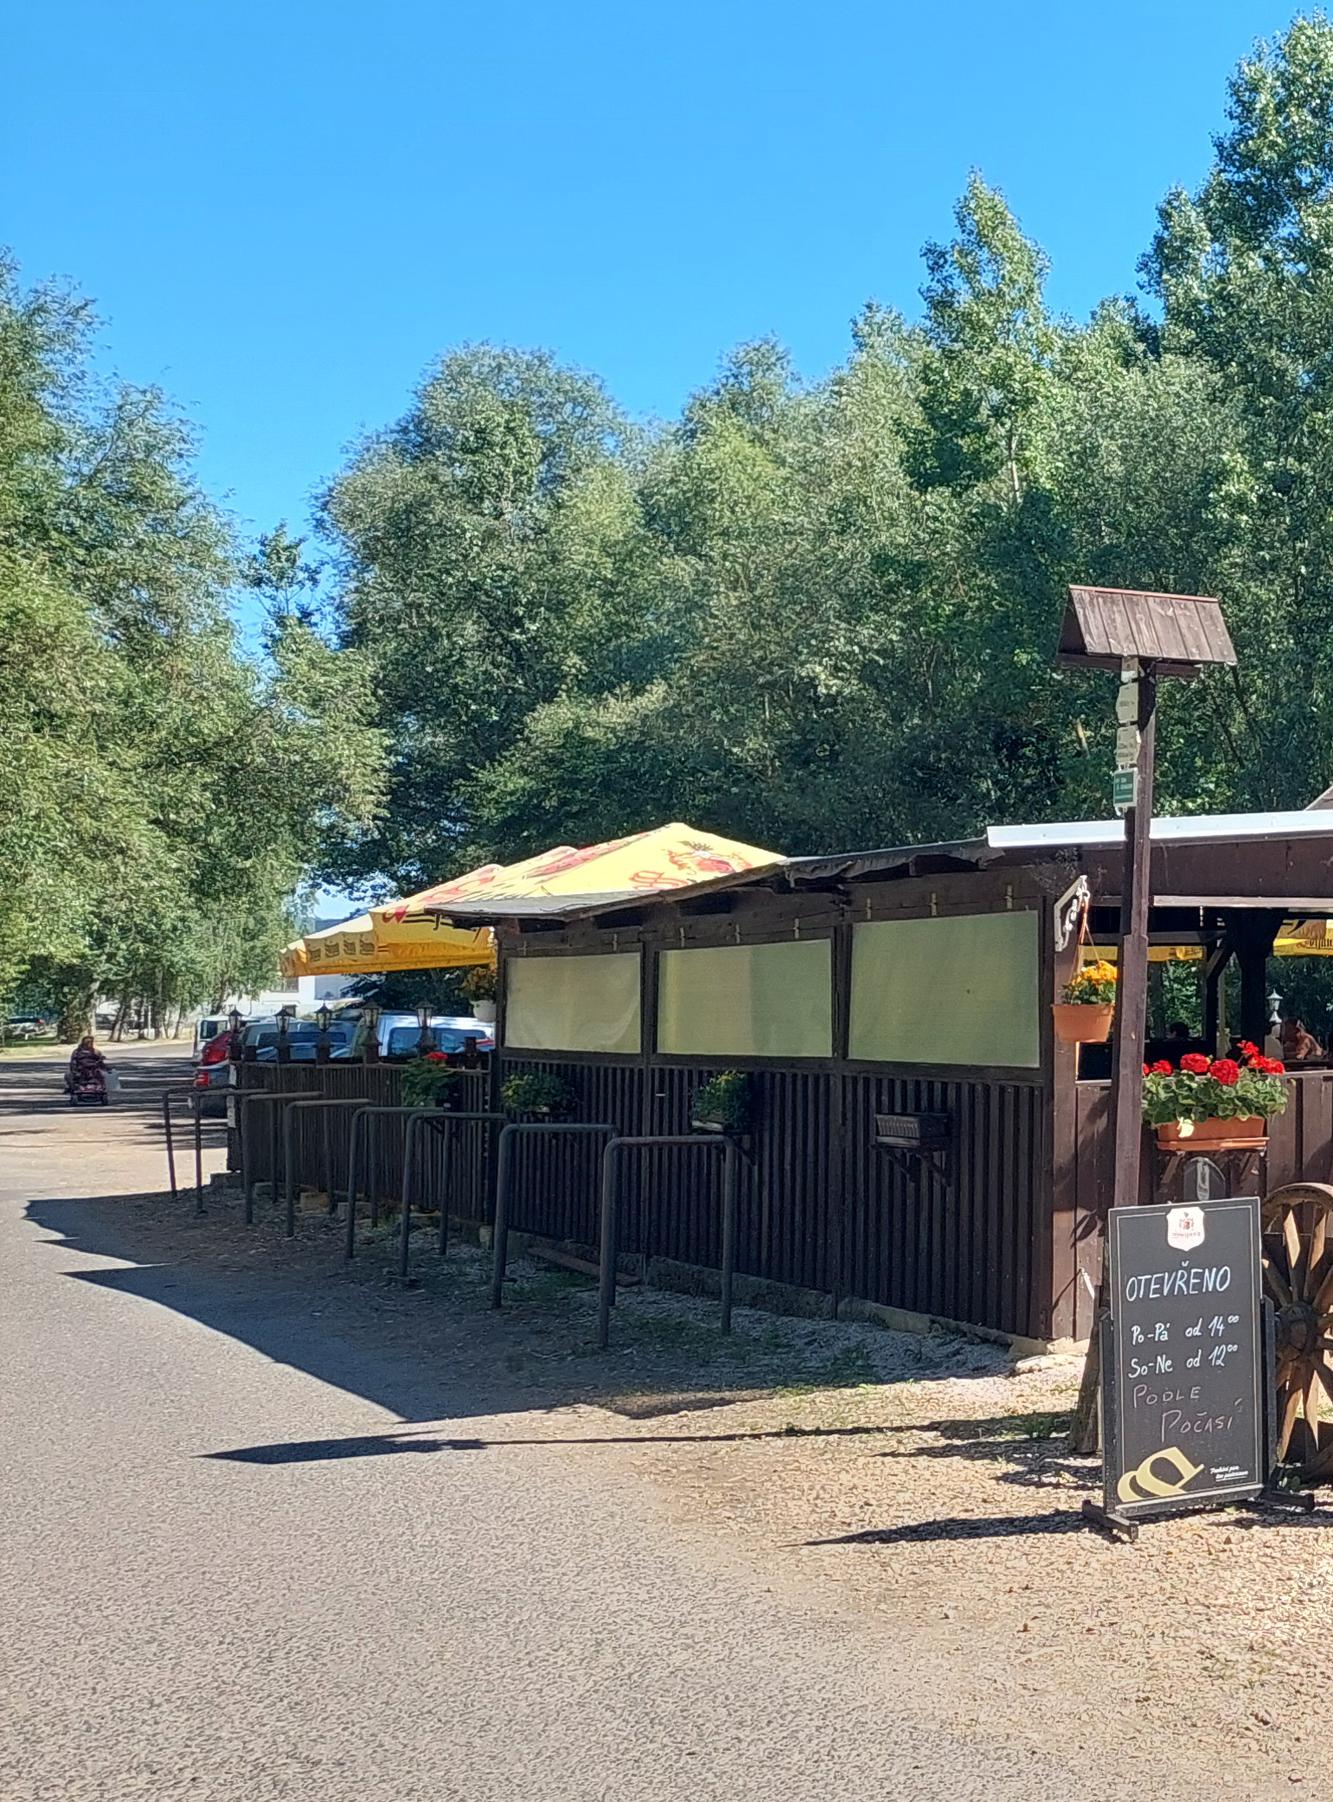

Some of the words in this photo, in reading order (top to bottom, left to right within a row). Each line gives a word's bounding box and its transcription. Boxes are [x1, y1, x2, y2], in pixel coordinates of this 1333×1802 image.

[1125, 1261, 1231, 1302] OTEVŘENO
[1131, 1323, 1171, 1345] Po-Pá
[1185, 1317, 1202, 1337] od
[1128, 1355, 1174, 1379] So-Ne
[1186, 1349, 1201, 1369] od
